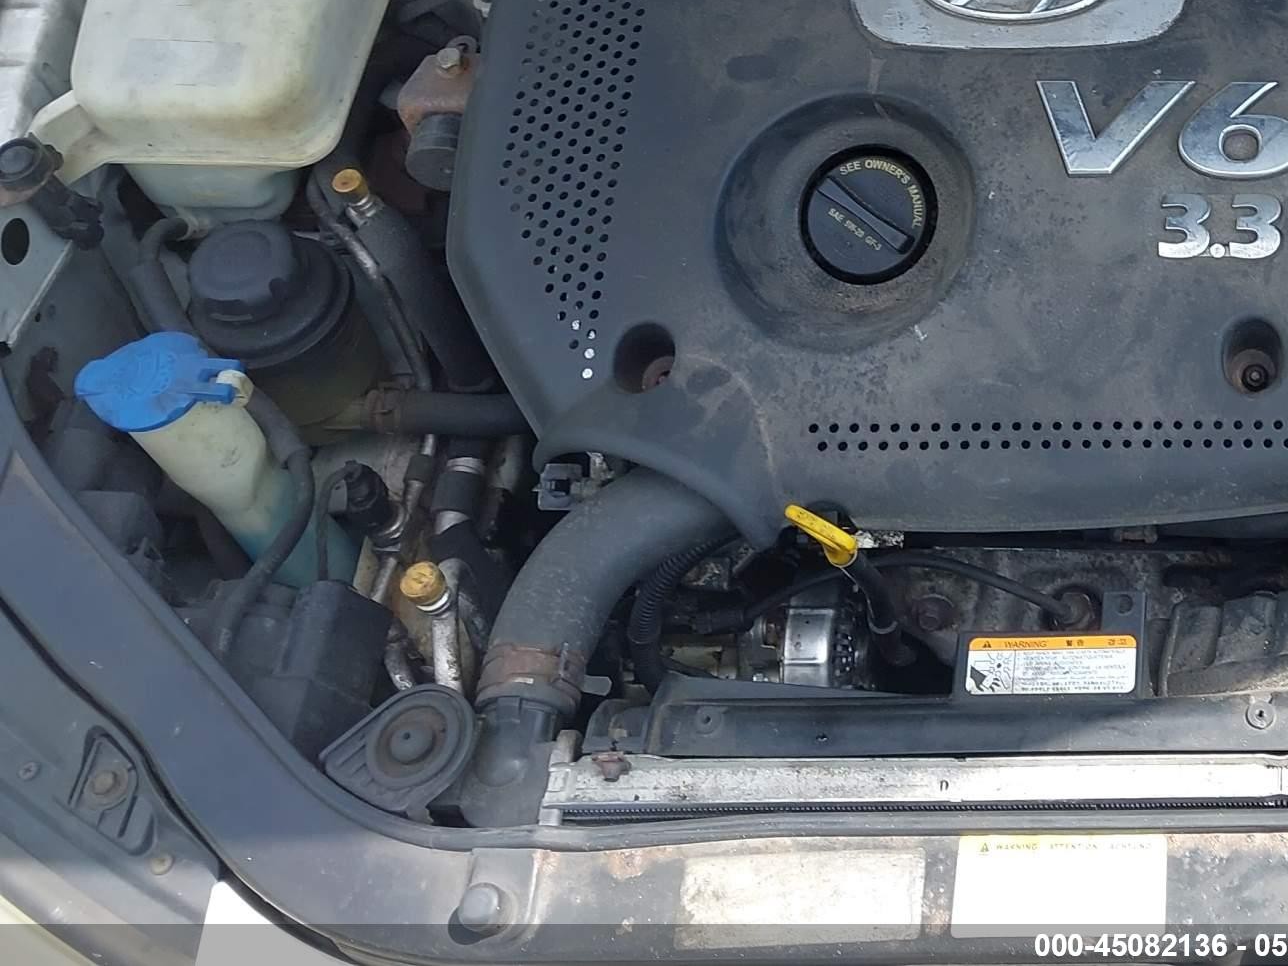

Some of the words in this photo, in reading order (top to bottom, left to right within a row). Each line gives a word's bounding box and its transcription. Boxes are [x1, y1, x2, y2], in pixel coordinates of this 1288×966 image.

[839, 160, 862, 176] SEE
[864, 159, 911, 185] OWNER'S
[907, 185, 924, 229] MANUAL
[828, 208, 845, 224] SAE
[1157, 193, 1282, 260] 3.3
[1004, 639, 1048, 649] WARNING
